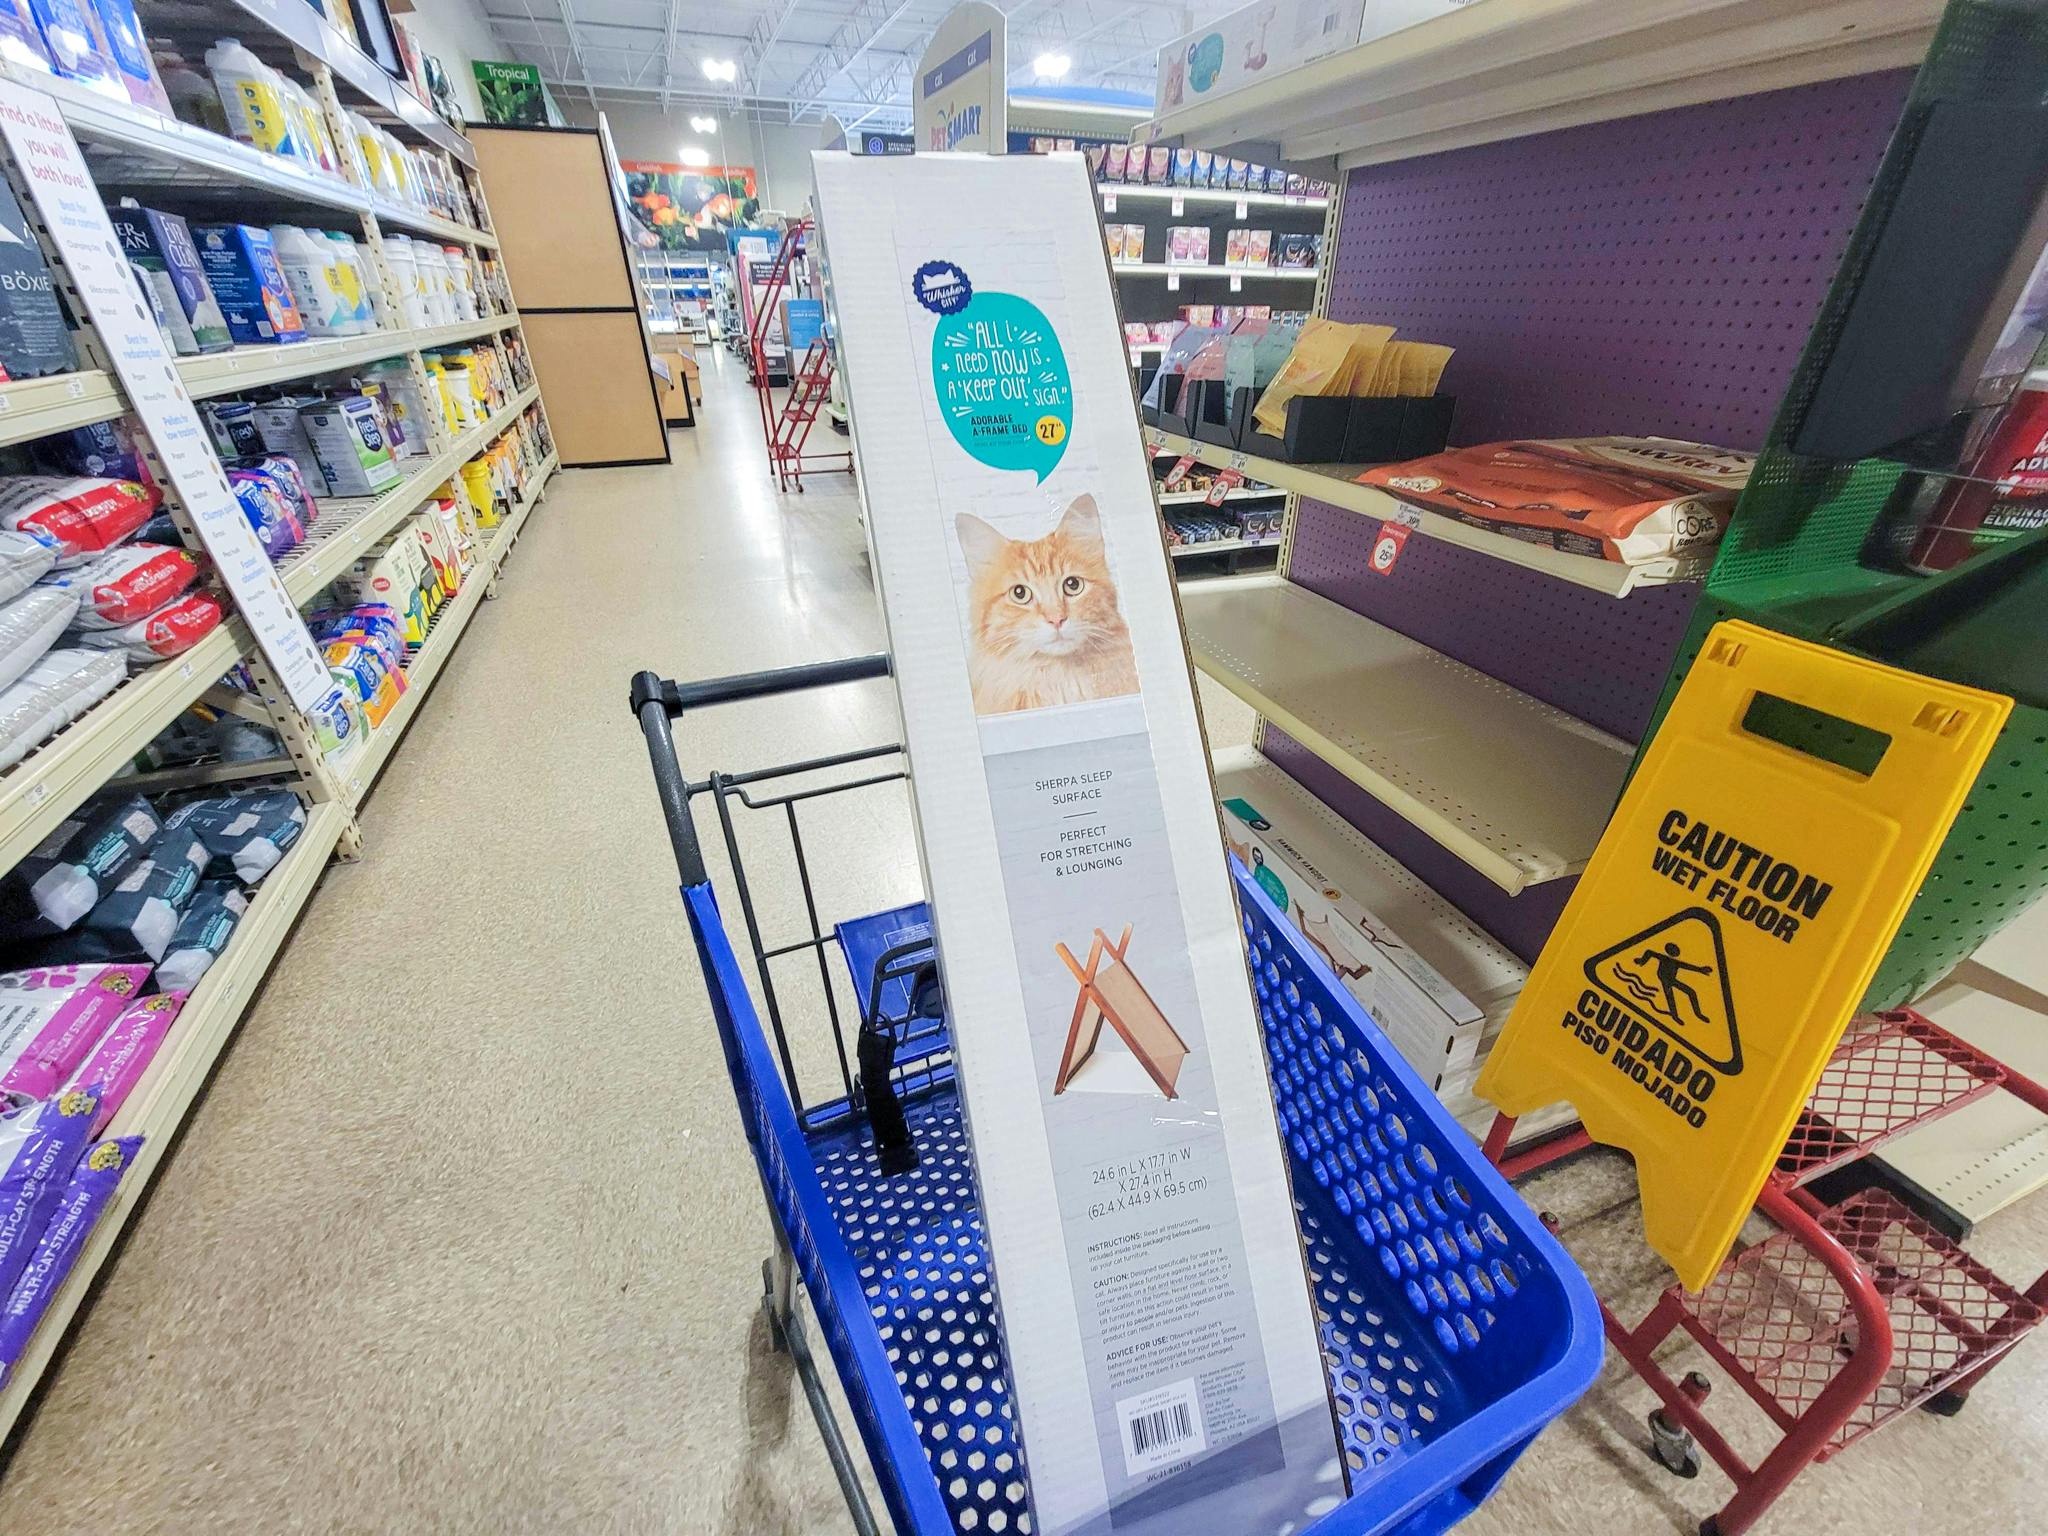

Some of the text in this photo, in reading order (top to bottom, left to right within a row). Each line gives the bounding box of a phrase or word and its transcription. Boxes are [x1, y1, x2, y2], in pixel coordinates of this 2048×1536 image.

[483, 64, 530, 82] Tropical
[34, 112, 65, 136] litter
[24, 138, 69, 161] you will
[28, 160, 60, 182] both
[1, 270, 50, 291] BÖXIE
[948, 380, 957, 399] A
[970, 414, 1014, 426] ADORABLE
[972, 424, 1028, 437] A-FRAME BED
[1677, 515, 1715, 537] CORE
[1035, 770, 1113, 791] SHERPA SLEEP
[1052, 788, 1102, 805] SURFACE
[1060, 826, 1107, 843] PERFECT
[1040, 838, 1133, 863] FOR STRETCHING
[1056, 856, 1123, 877] & LOUNGING
[1657, 809, 1833, 920] CAUTION
[1651, 847, 1801, 944] WET FLOOR
[1576, 989, 1716, 1102] CUIDADO
[1562, 1011, 1707, 1129] PISO MOJADO
[21, 1139, 64, 1200] STRENGTH
[1092, 1147, 1191, 1184] 24.6 in L X 17.7 in W
[1118, 1168, 1173, 1194] X 27.4 in H
[1088, 1176, 1208, 1220] (62.4 X 44.9 X 69.5 cm)
[12, 1191, 92, 1315] MULTI-CAT STRENGTH
[1087, 1232, 1142, 1253] INSTRUCTIONS:
[1093, 1273, 1129, 1289] CAUTION:
[1106, 1346, 1134, 1361] ADVICE
[1135, 1341, 1151, 1352] FOR
[1152, 1336, 1168, 1346] USE:
